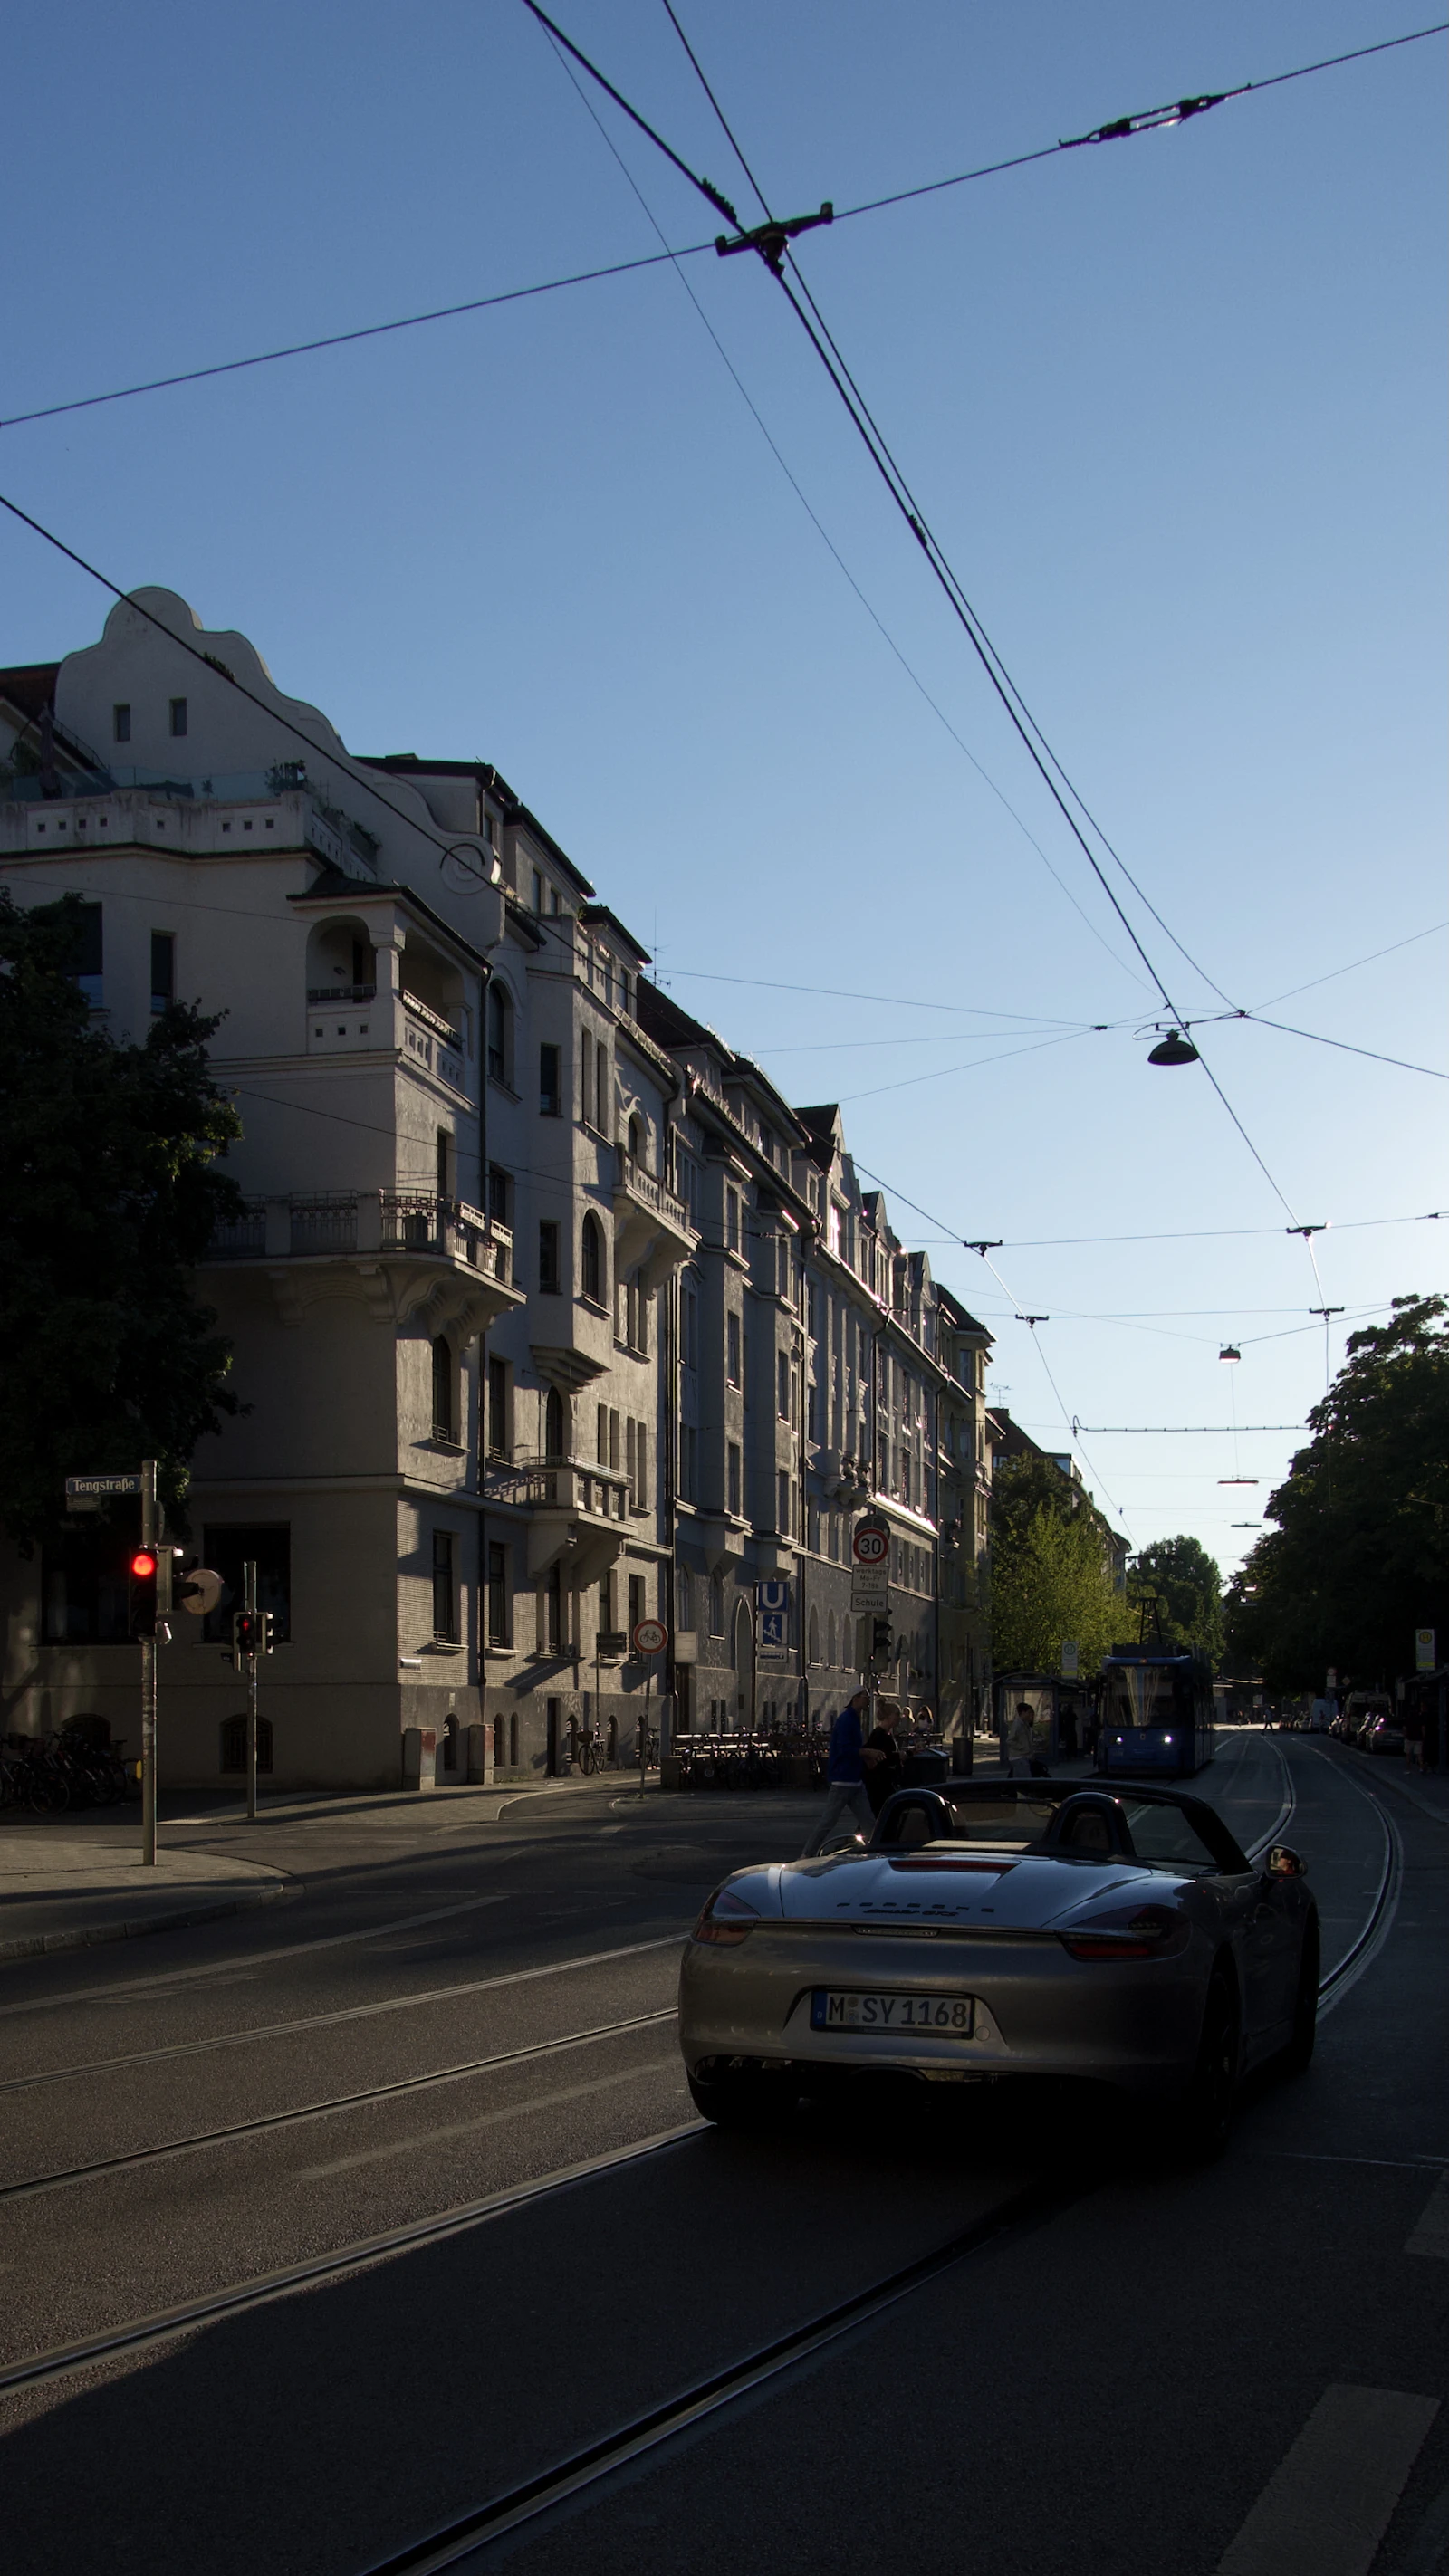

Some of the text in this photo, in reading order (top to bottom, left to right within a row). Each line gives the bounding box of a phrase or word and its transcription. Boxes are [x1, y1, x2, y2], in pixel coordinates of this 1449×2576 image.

[73, 1478, 135, 1494] Tengstraße
[860, 1538, 881, 1555] 30
[856, 1567, 887, 1575] werktags
[762, 1583, 784, 1610] U
[855, 1597, 884, 1607] Schule
[817, 2010, 823, 2019] D
[828, 1997, 845, 2022] M
[900, 1999, 968, 2028] 1168
